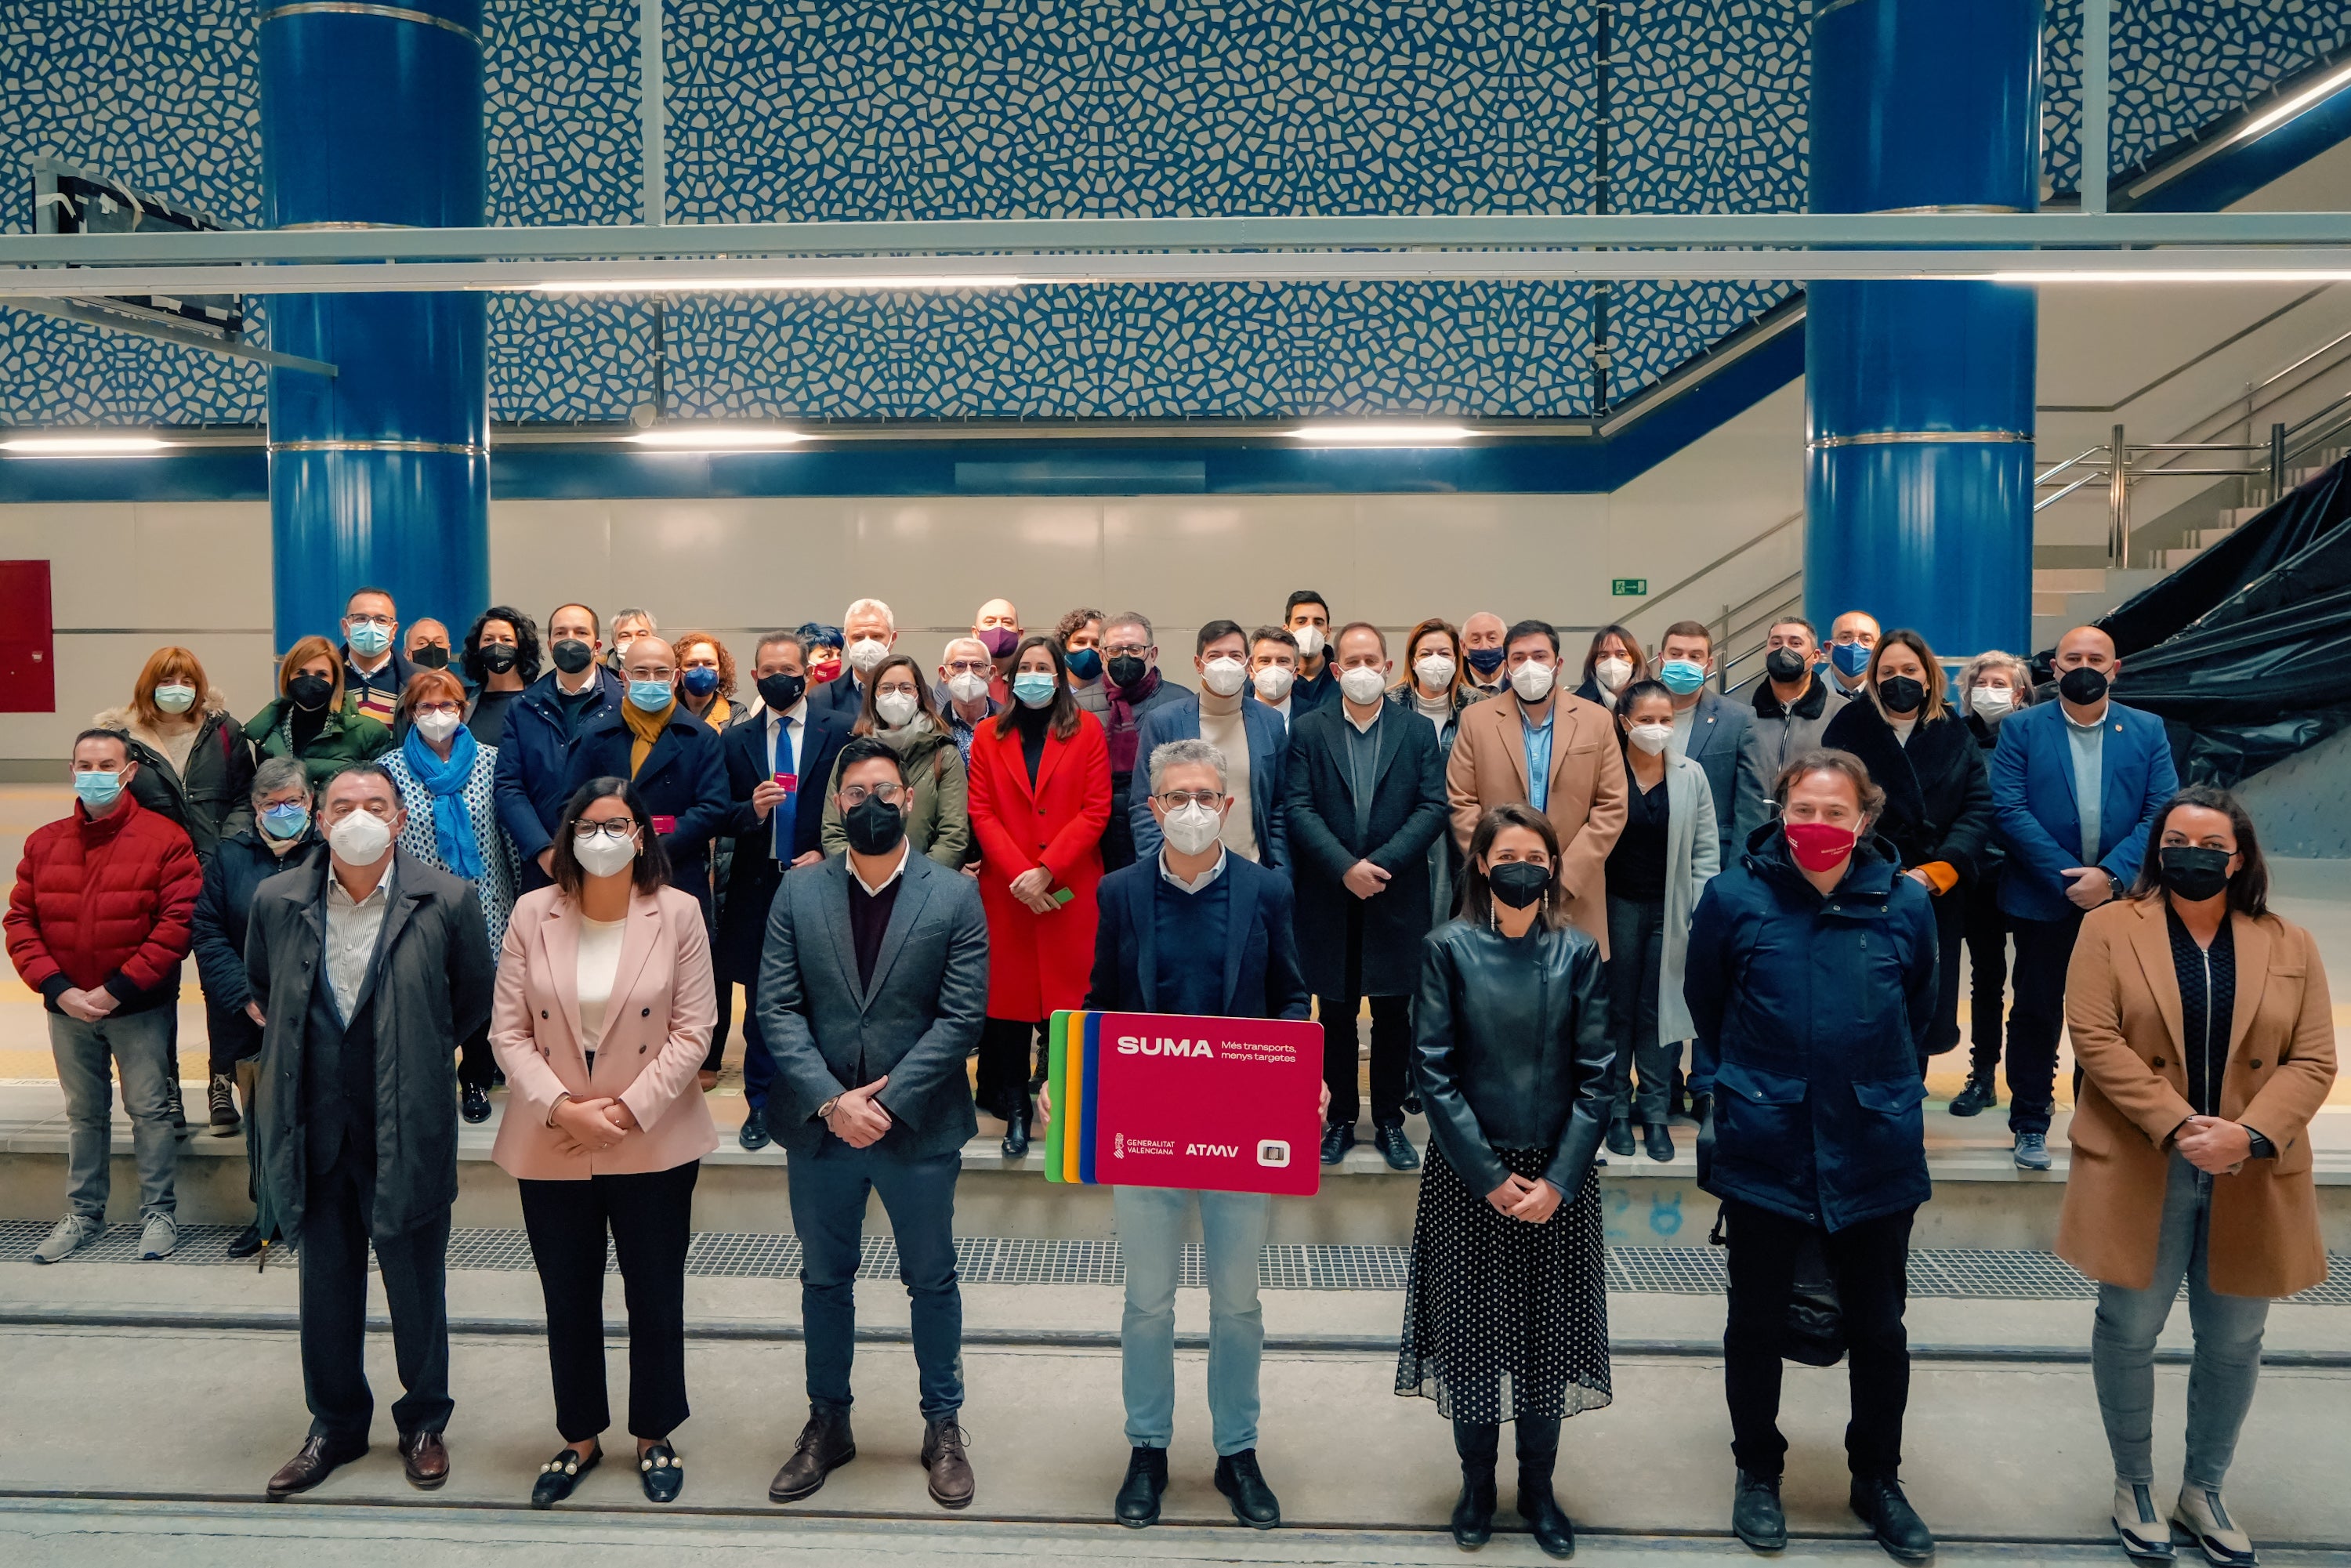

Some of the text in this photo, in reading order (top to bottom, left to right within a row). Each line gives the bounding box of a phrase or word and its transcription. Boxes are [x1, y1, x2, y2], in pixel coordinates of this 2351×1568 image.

[1117, 1036, 1214, 1058] SUMA
[1221, 1041, 1297, 1053] Més transports,
[1221, 1052, 1296, 1063] menys targetes
[1126, 1139, 1176, 1148] GENERALITAT
[1127, 1146, 1174, 1156] VALENCIANA
[1186, 1143, 1239, 1158] ATMV
